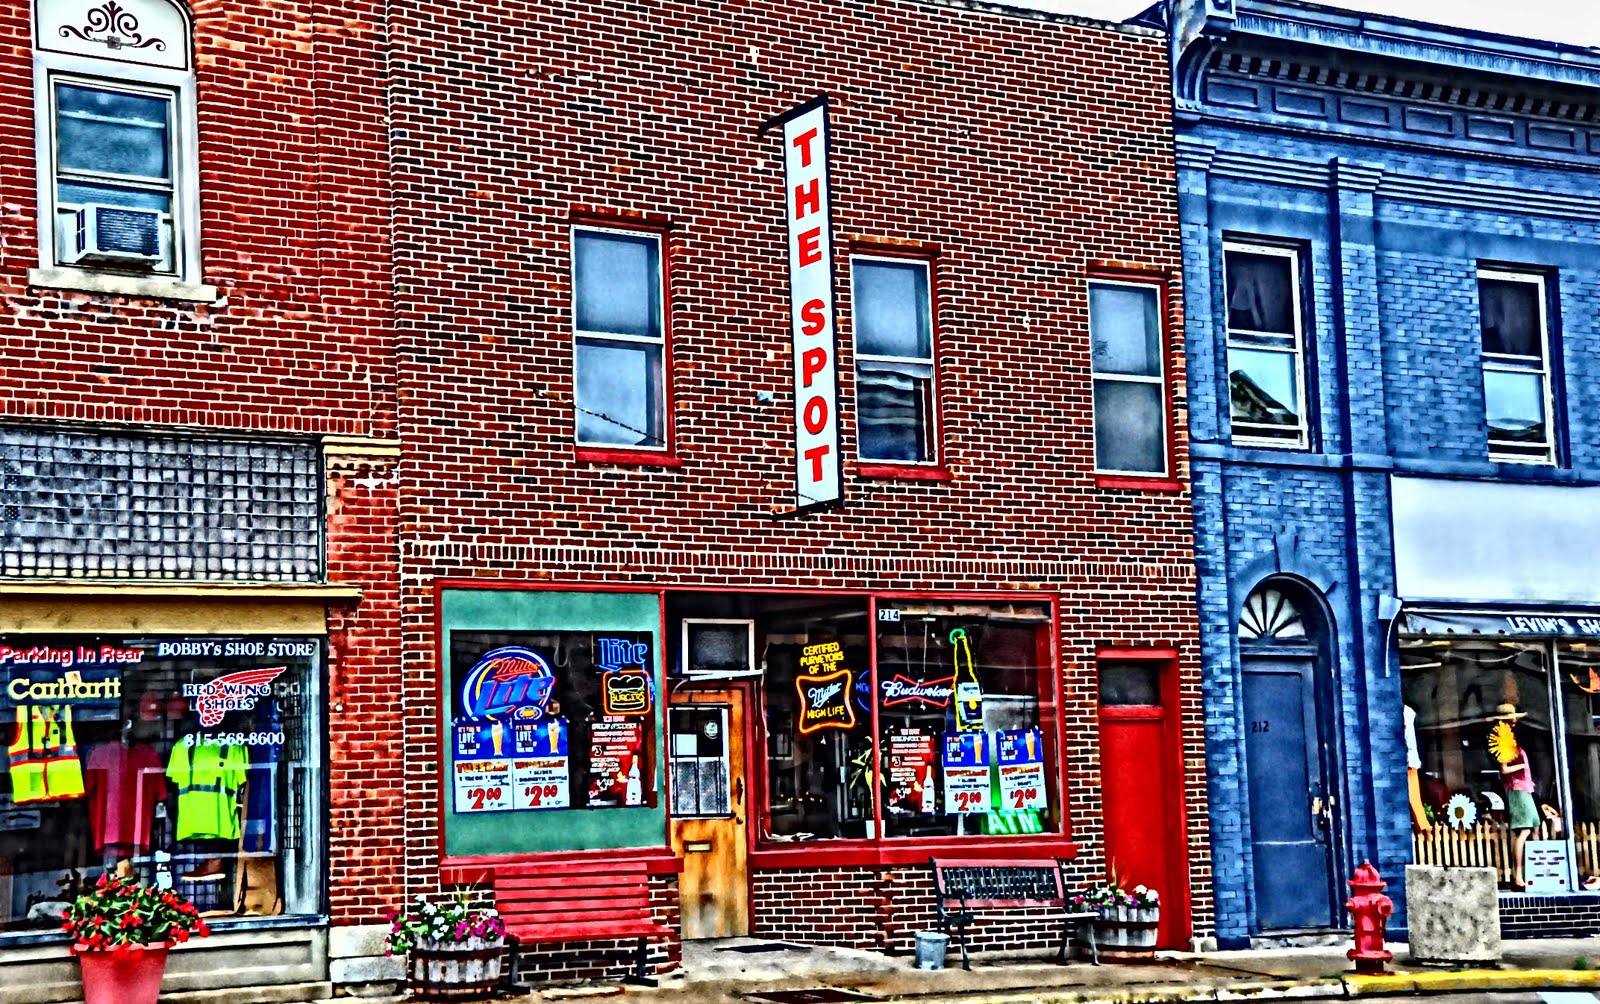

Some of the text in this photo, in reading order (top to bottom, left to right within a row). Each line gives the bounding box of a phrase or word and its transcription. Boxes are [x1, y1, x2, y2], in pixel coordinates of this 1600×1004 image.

[793, 127, 830, 482] THE SPOT
[880, 610, 899, 620] 214
[1506, 617, 1600, 635] LEVIN'S SH
[158, 641, 314, 656] BOBBY's SHOE STORE
[803, 642, 840, 656] CERTIFIED
[0, 645, 144, 667] Parking In Rear
[491, 658, 542, 680] Miller
[809, 661, 838, 675] OF THE
[8, 677, 121, 700] Carhartt
[184, 683, 271, 696] RED WING
[472, 674, 556, 717] Lite
[881, 680, 955, 697] Budweiser
[204, 697, 255, 711] SHOES
[611, 692, 645, 702] BURGERS
[807, 705, 845, 719] HIGH LIFE
[1252, 721, 1269, 733] 212
[184, 732, 285, 746] 815-568-8600
[459, 732, 475, 743] LOVE
[516, 730, 532, 742] LOVE
[987, 805, 1043, 834] ATM
